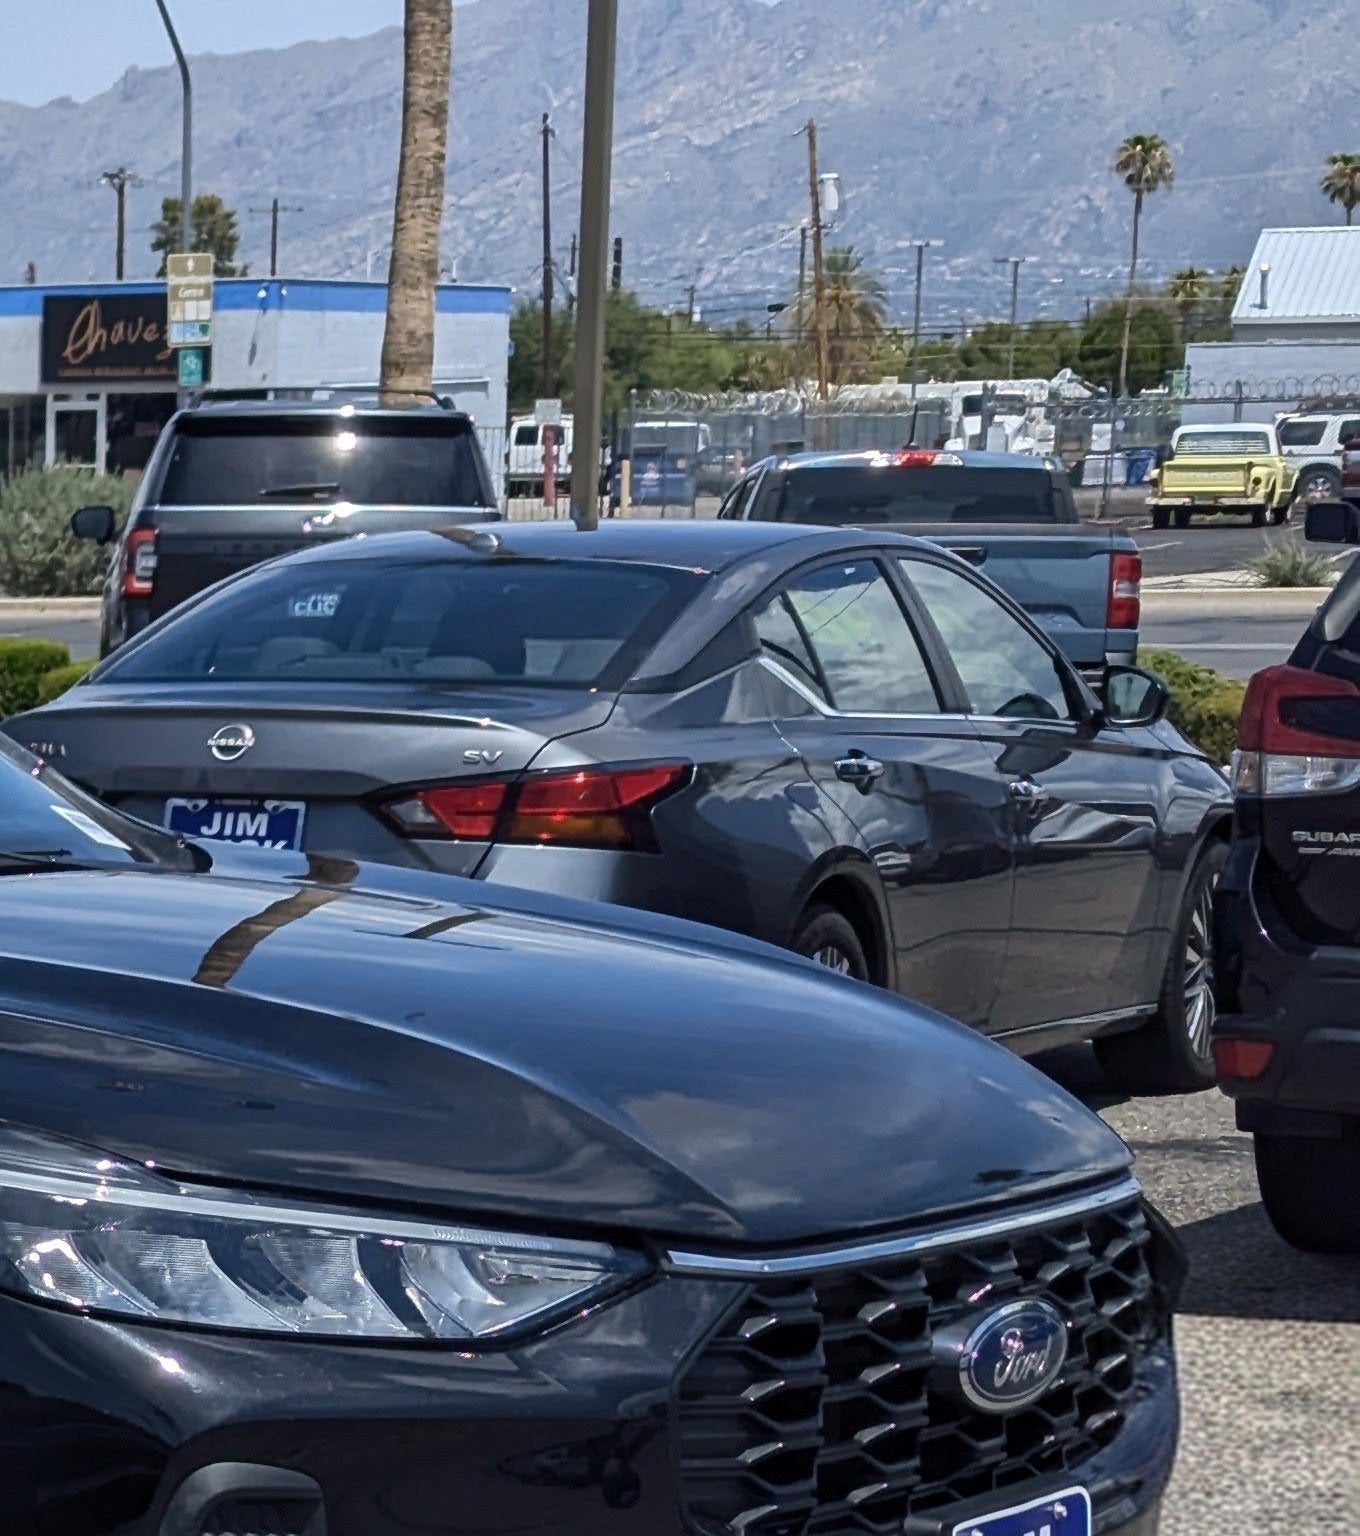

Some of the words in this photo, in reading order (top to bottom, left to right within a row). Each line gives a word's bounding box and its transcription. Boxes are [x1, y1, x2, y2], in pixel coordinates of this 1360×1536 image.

[63, 300, 173, 364] Chave
[207, 737, 255, 747] NISSAN
[463, 750, 503, 765] SV
[200, 812, 269, 836] JIM
[993, 1327, 1052, 1388] Ford
